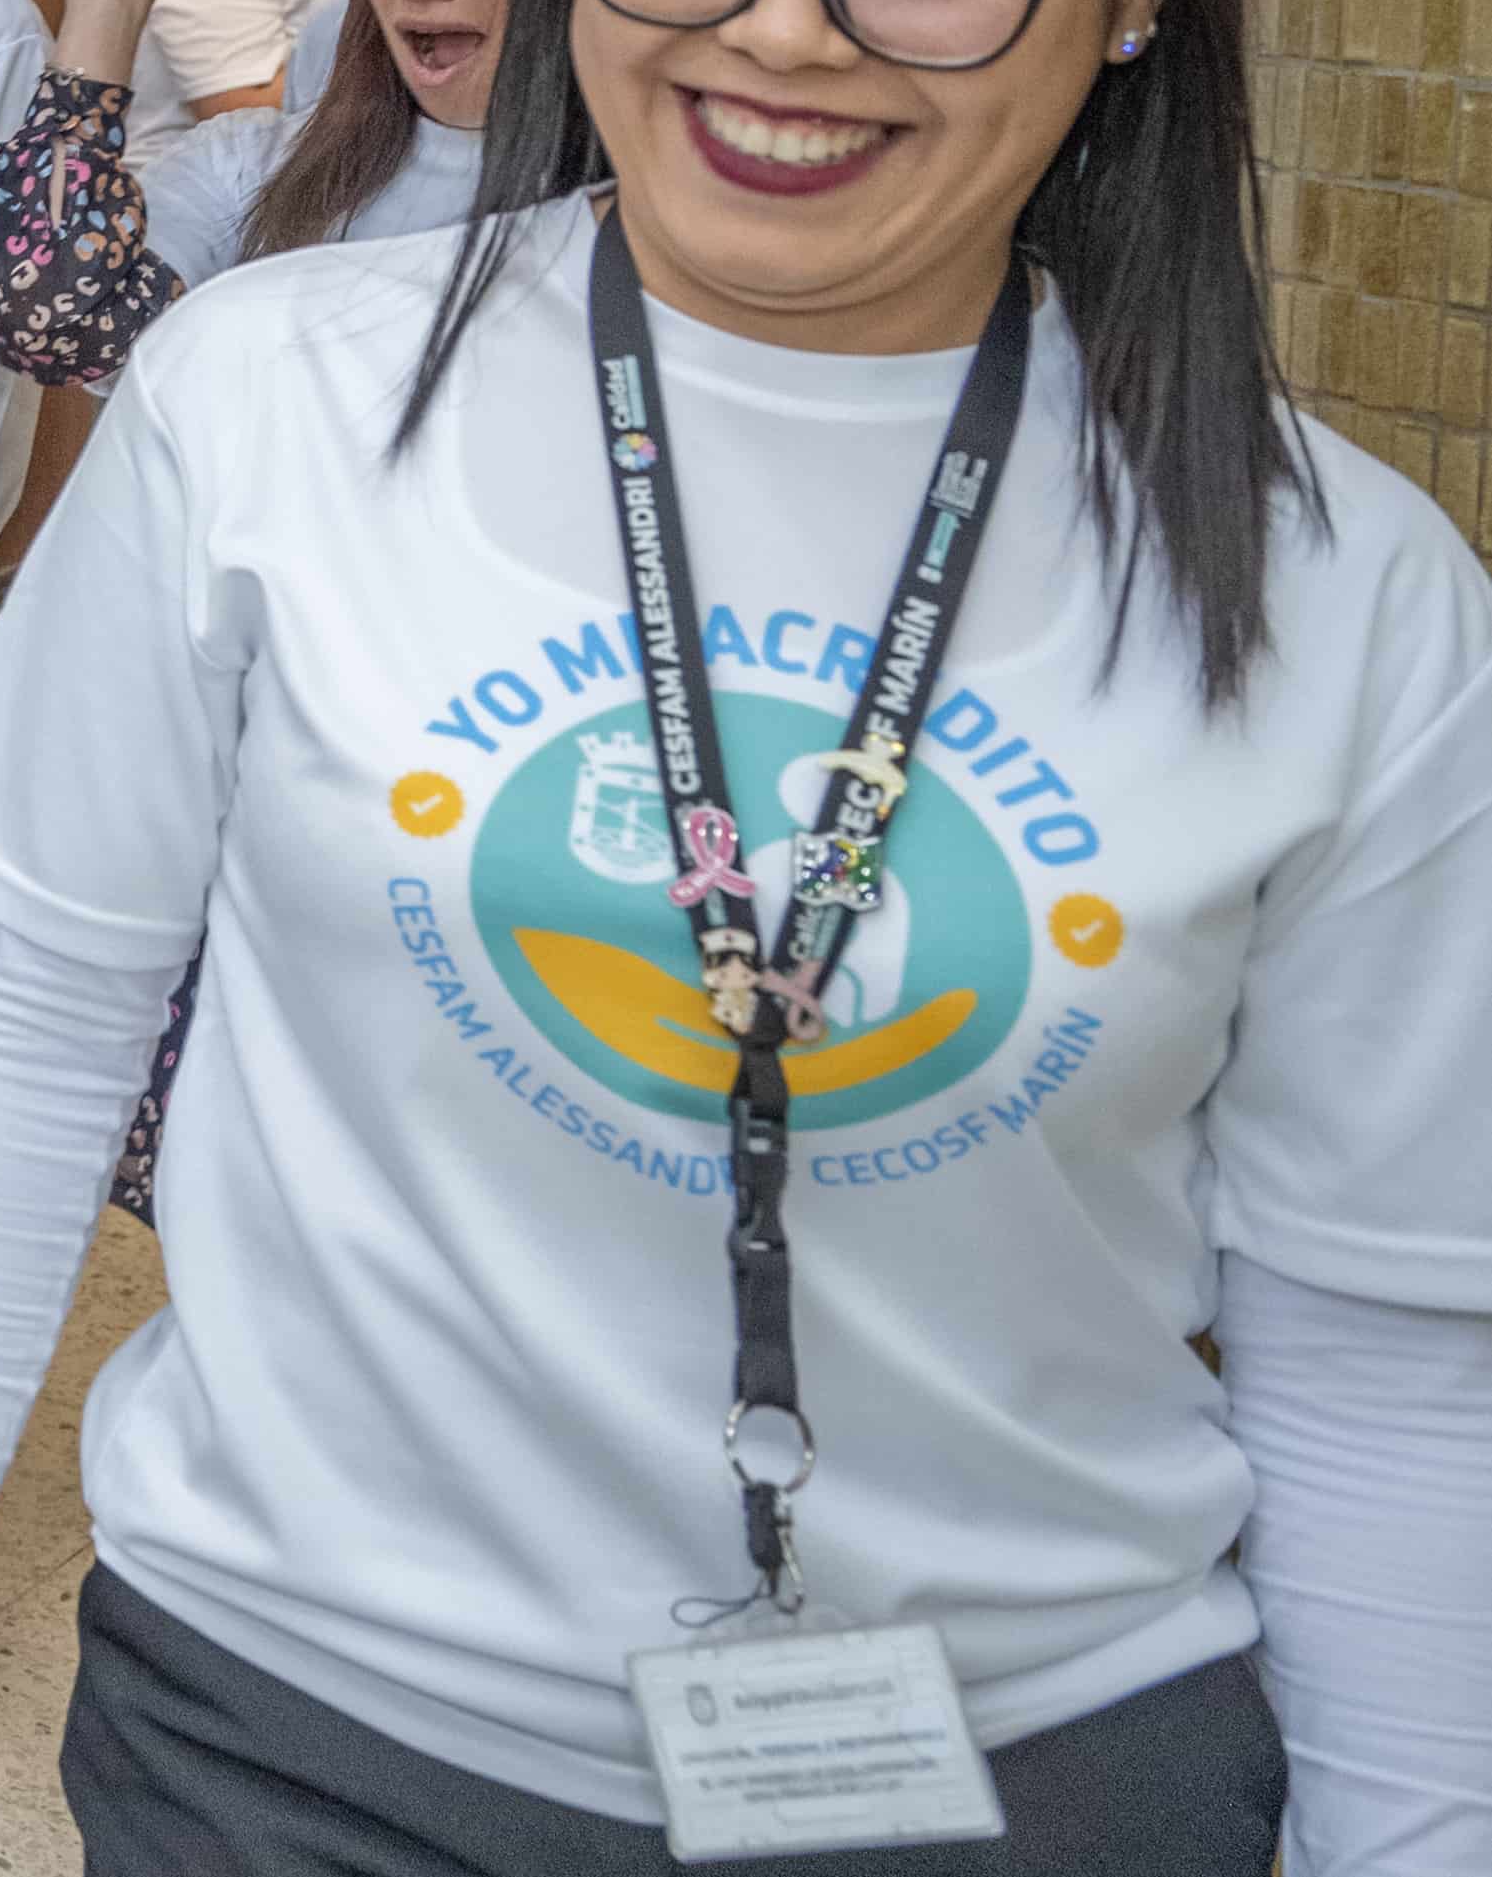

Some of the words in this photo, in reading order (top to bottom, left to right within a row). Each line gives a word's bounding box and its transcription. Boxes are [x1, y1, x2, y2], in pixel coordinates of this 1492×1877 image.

[621, 476, 681, 665] ALESSANDRI
[874, 596, 941, 716] MARÍN
[427, 669, 544, 757] YO
[701, 603, 1101, 869] ACRDITO
[654, 665, 701, 795] CESFAM
[387, 875, 492, 1041] CESFAM
[481, 1042, 735, 1197] ALESSAND
[811, 1111, 991, 1189] CECOSF
[989, 1007, 1104, 1136] MARÍN
